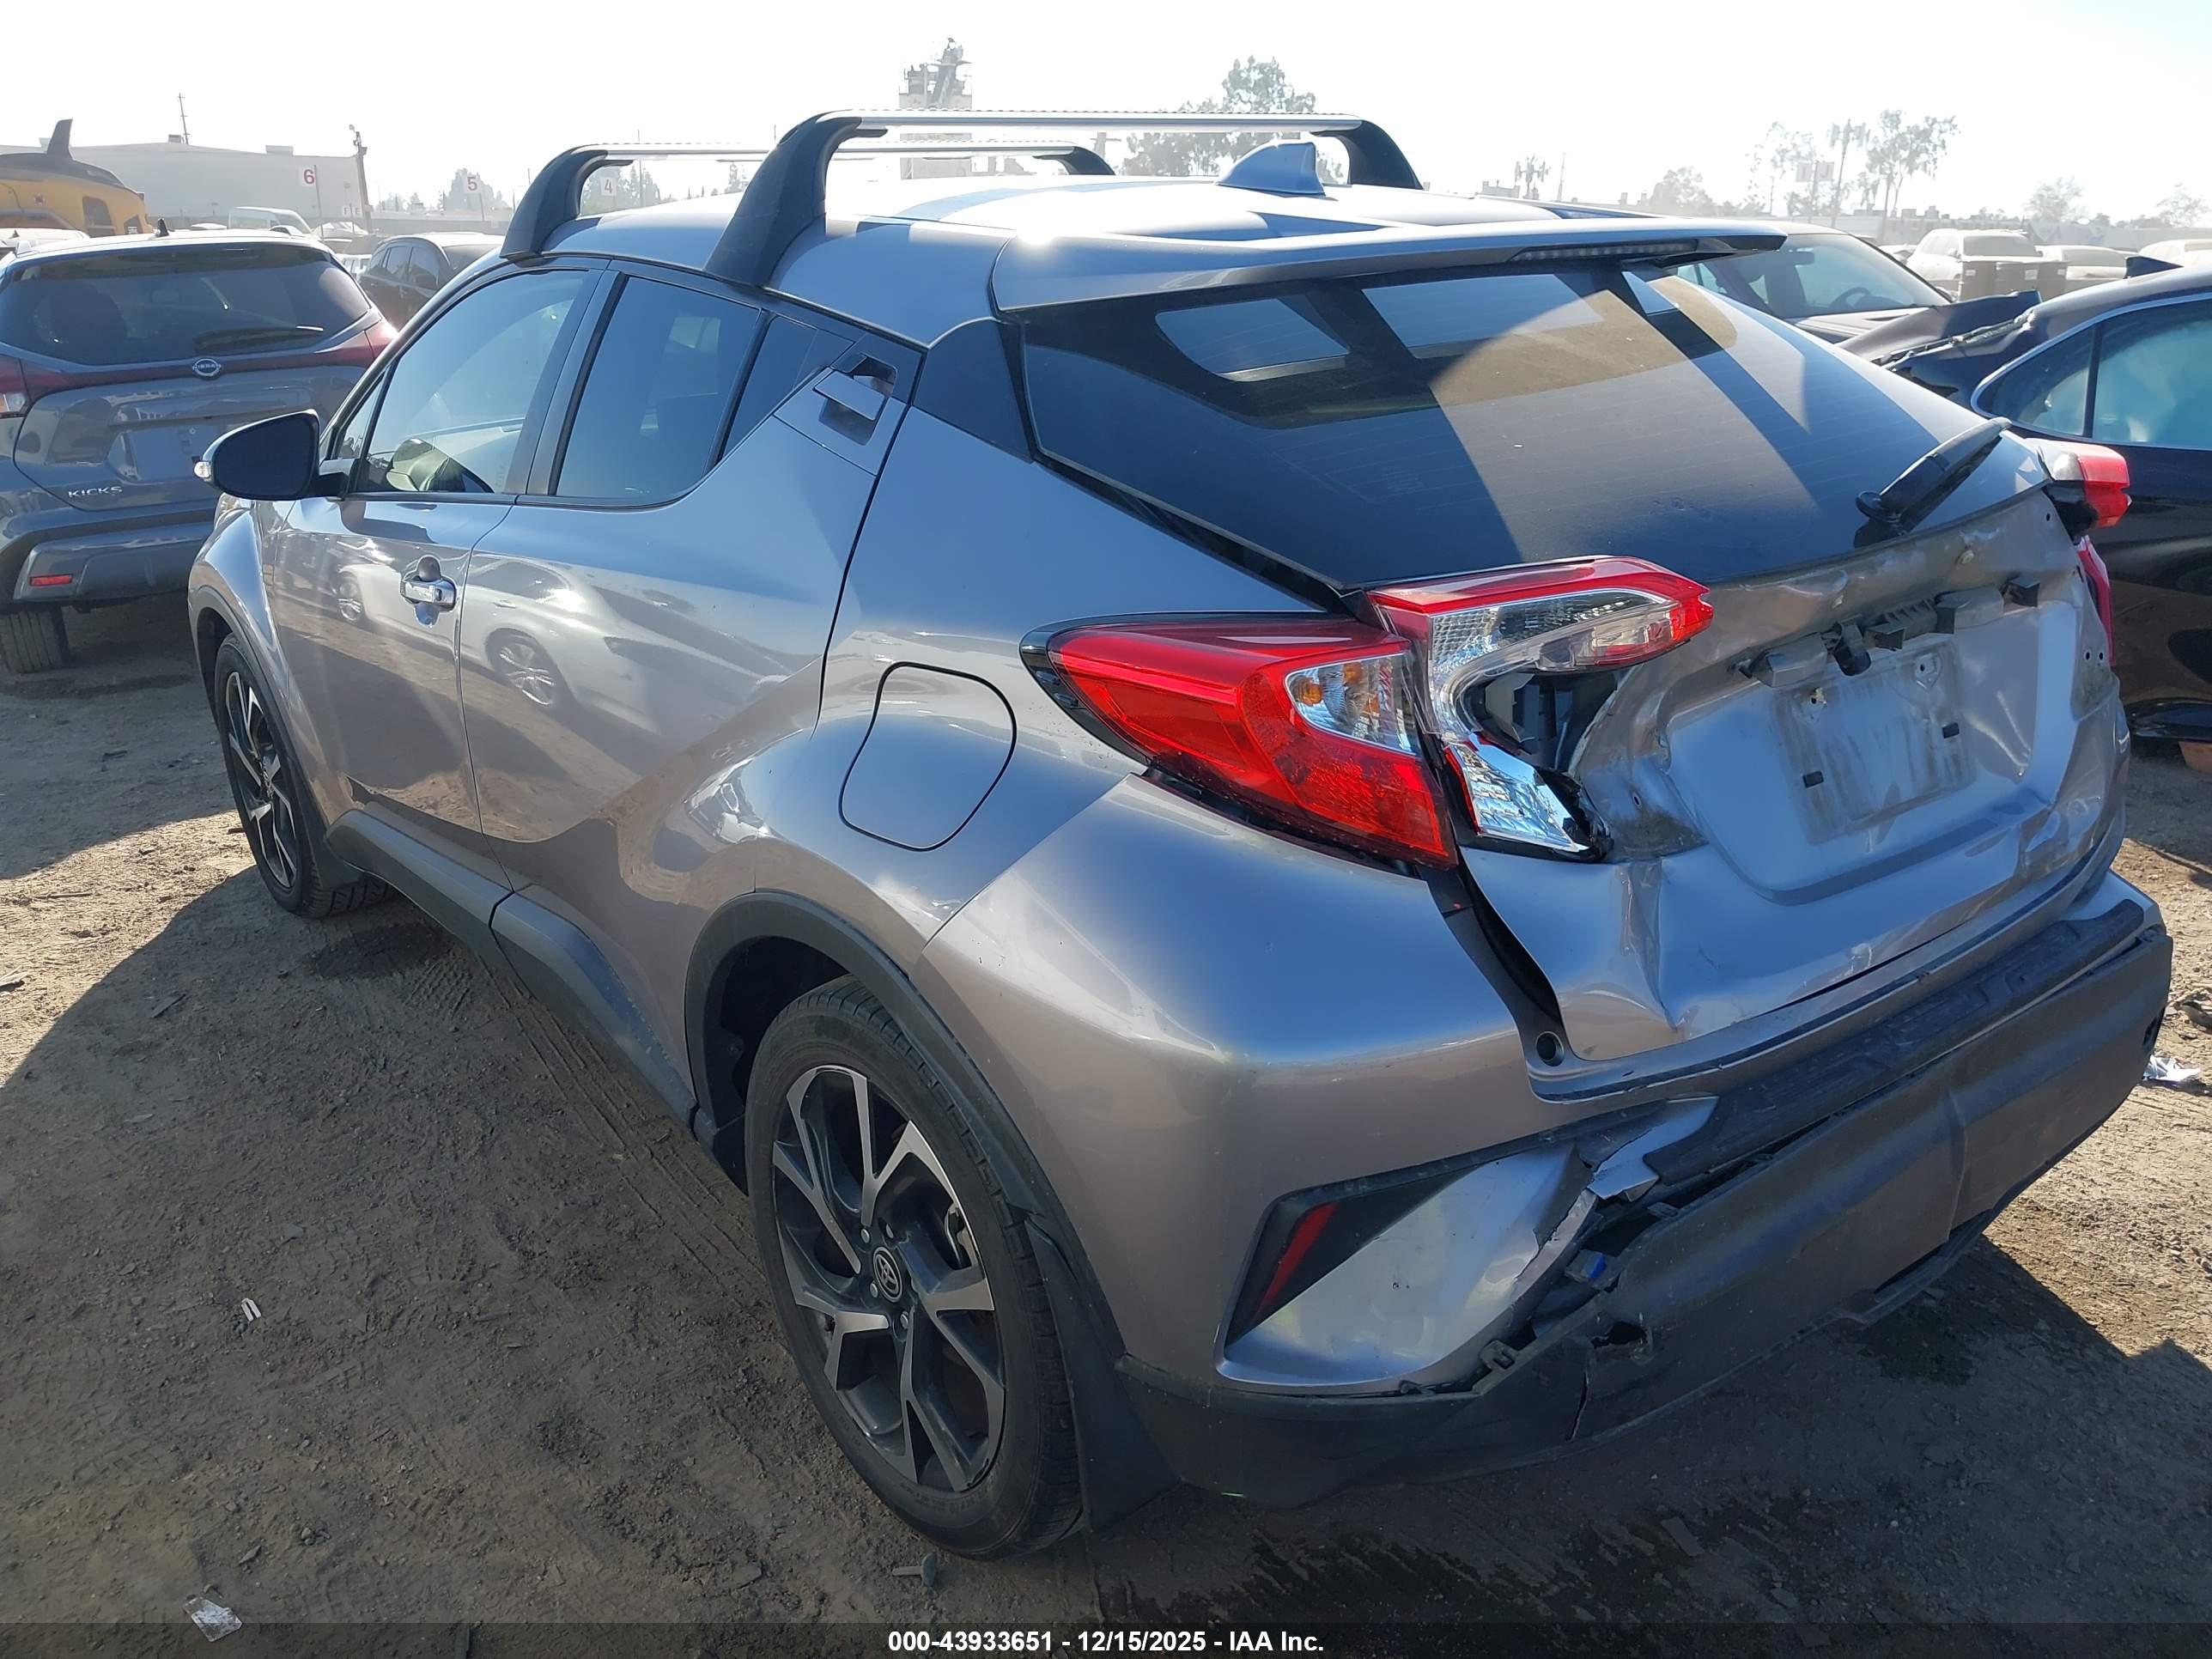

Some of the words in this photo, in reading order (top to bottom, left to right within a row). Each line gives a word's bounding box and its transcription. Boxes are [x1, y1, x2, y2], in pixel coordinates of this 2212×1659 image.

[303, 169, 315, 185] 6
[467, 176, 478, 191] 5
[605, 179, 613, 193] 4
[68, 486, 123, 497] KICKS
